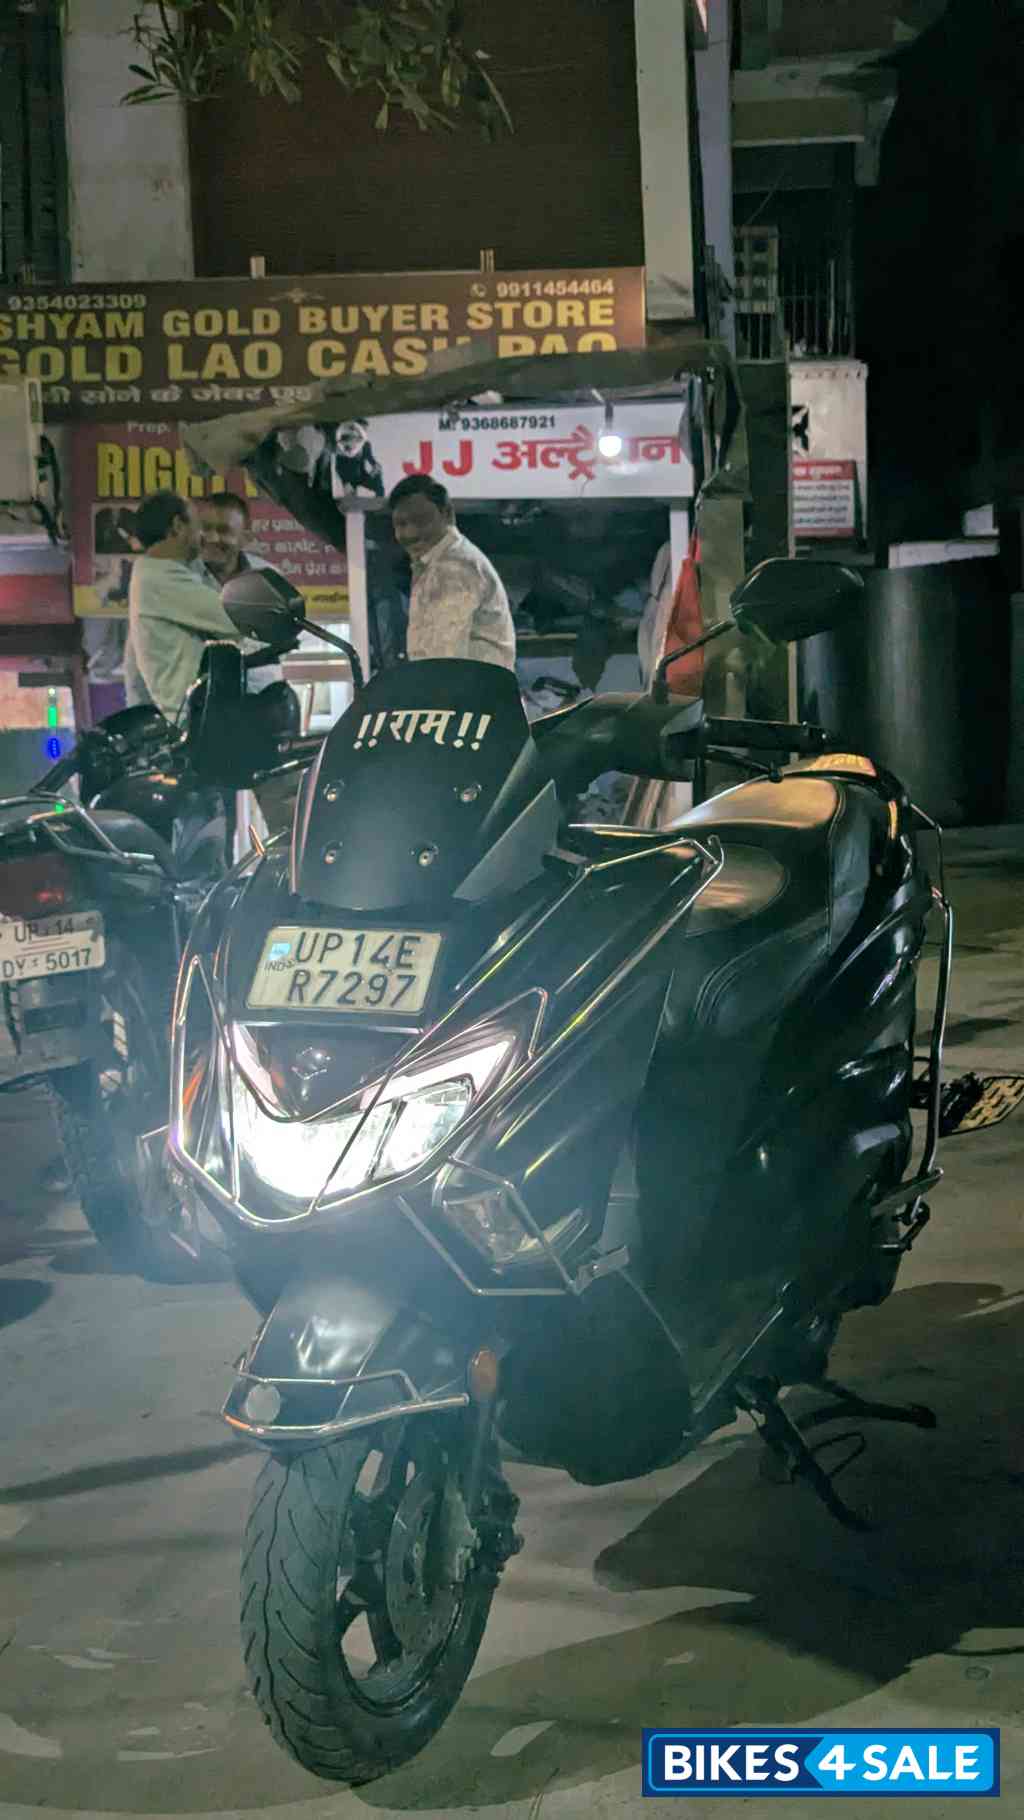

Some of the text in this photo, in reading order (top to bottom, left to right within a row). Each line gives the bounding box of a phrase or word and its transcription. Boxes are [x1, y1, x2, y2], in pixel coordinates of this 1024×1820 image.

[162, 309, 281, 337] GOLD
[298, 303, 449, 334] BUYER
[466, 299, 615, 329] STORE
[168, 341, 283, 380] LAO
[461, 415, 556, 430] 9368687921
[46, 947, 91, 971] 5017
[287, 968, 417, 1008] R7297
